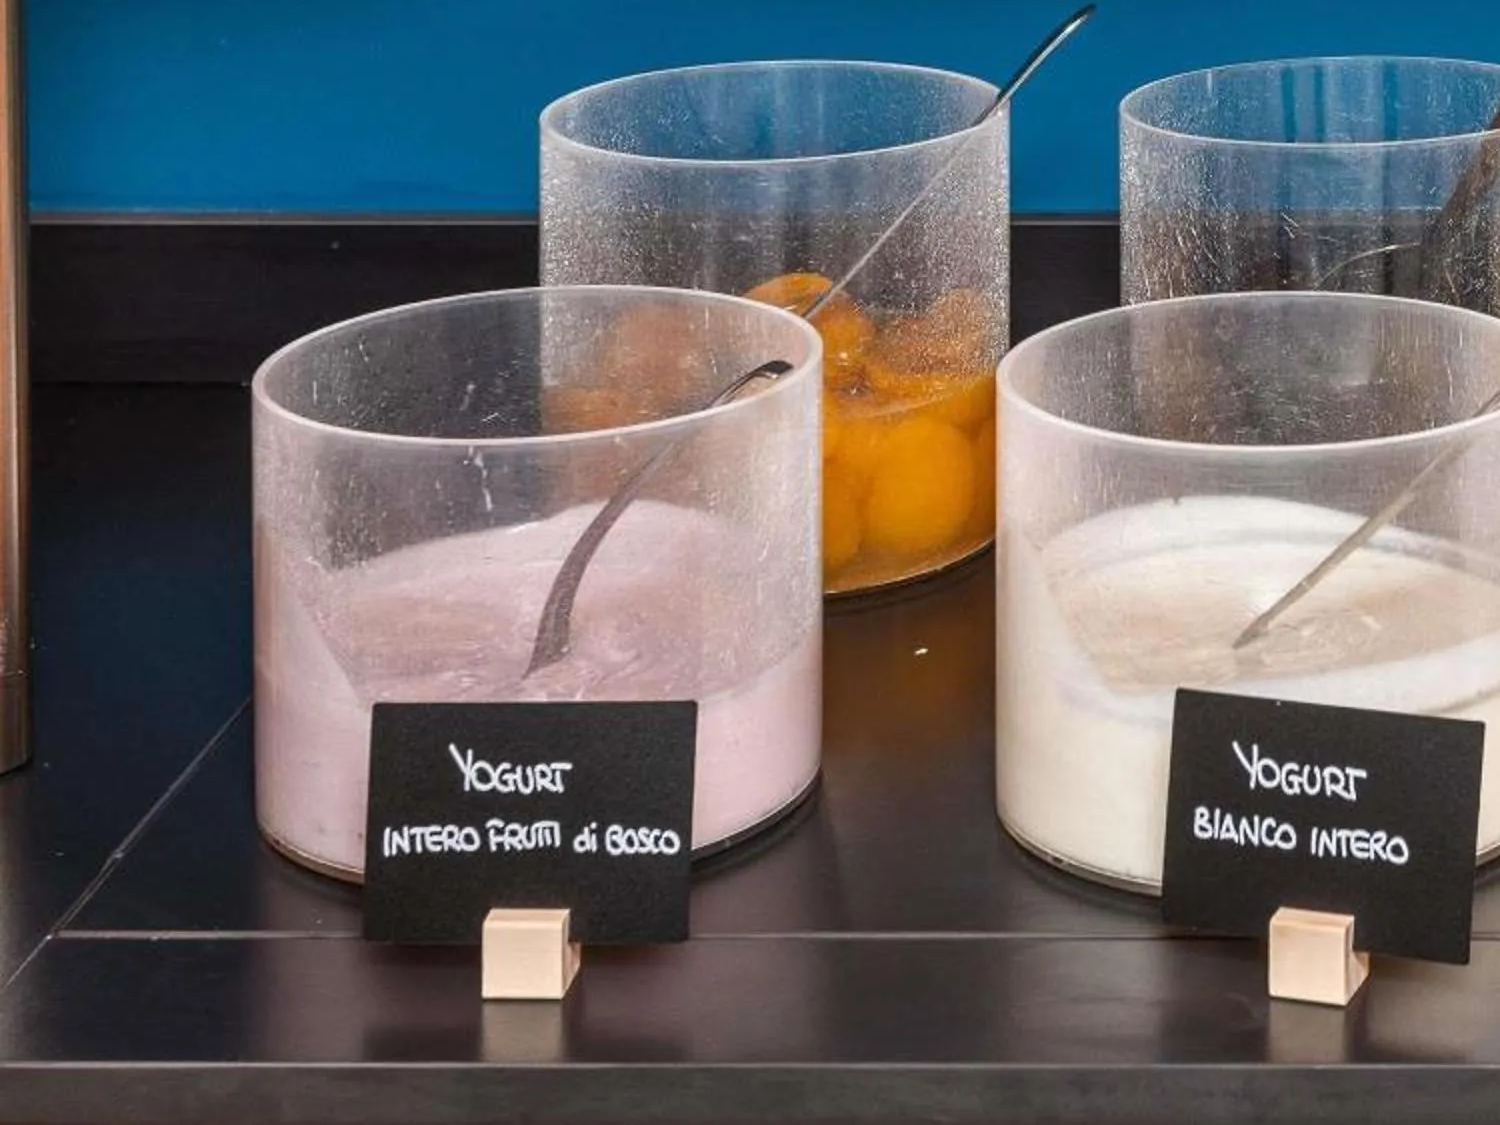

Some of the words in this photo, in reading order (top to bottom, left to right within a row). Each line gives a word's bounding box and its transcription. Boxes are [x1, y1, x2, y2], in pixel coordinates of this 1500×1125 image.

[448, 743, 573, 795] YOGURT
[1231, 740, 1368, 802] YOGURT
[383, 824, 481, 858] INTERO
[572, 821, 598, 854] di
[604, 823, 681, 856] BOSCO
[1193, 805, 1297, 850] BIANCO
[1310, 826, 1410, 865] INTERO
